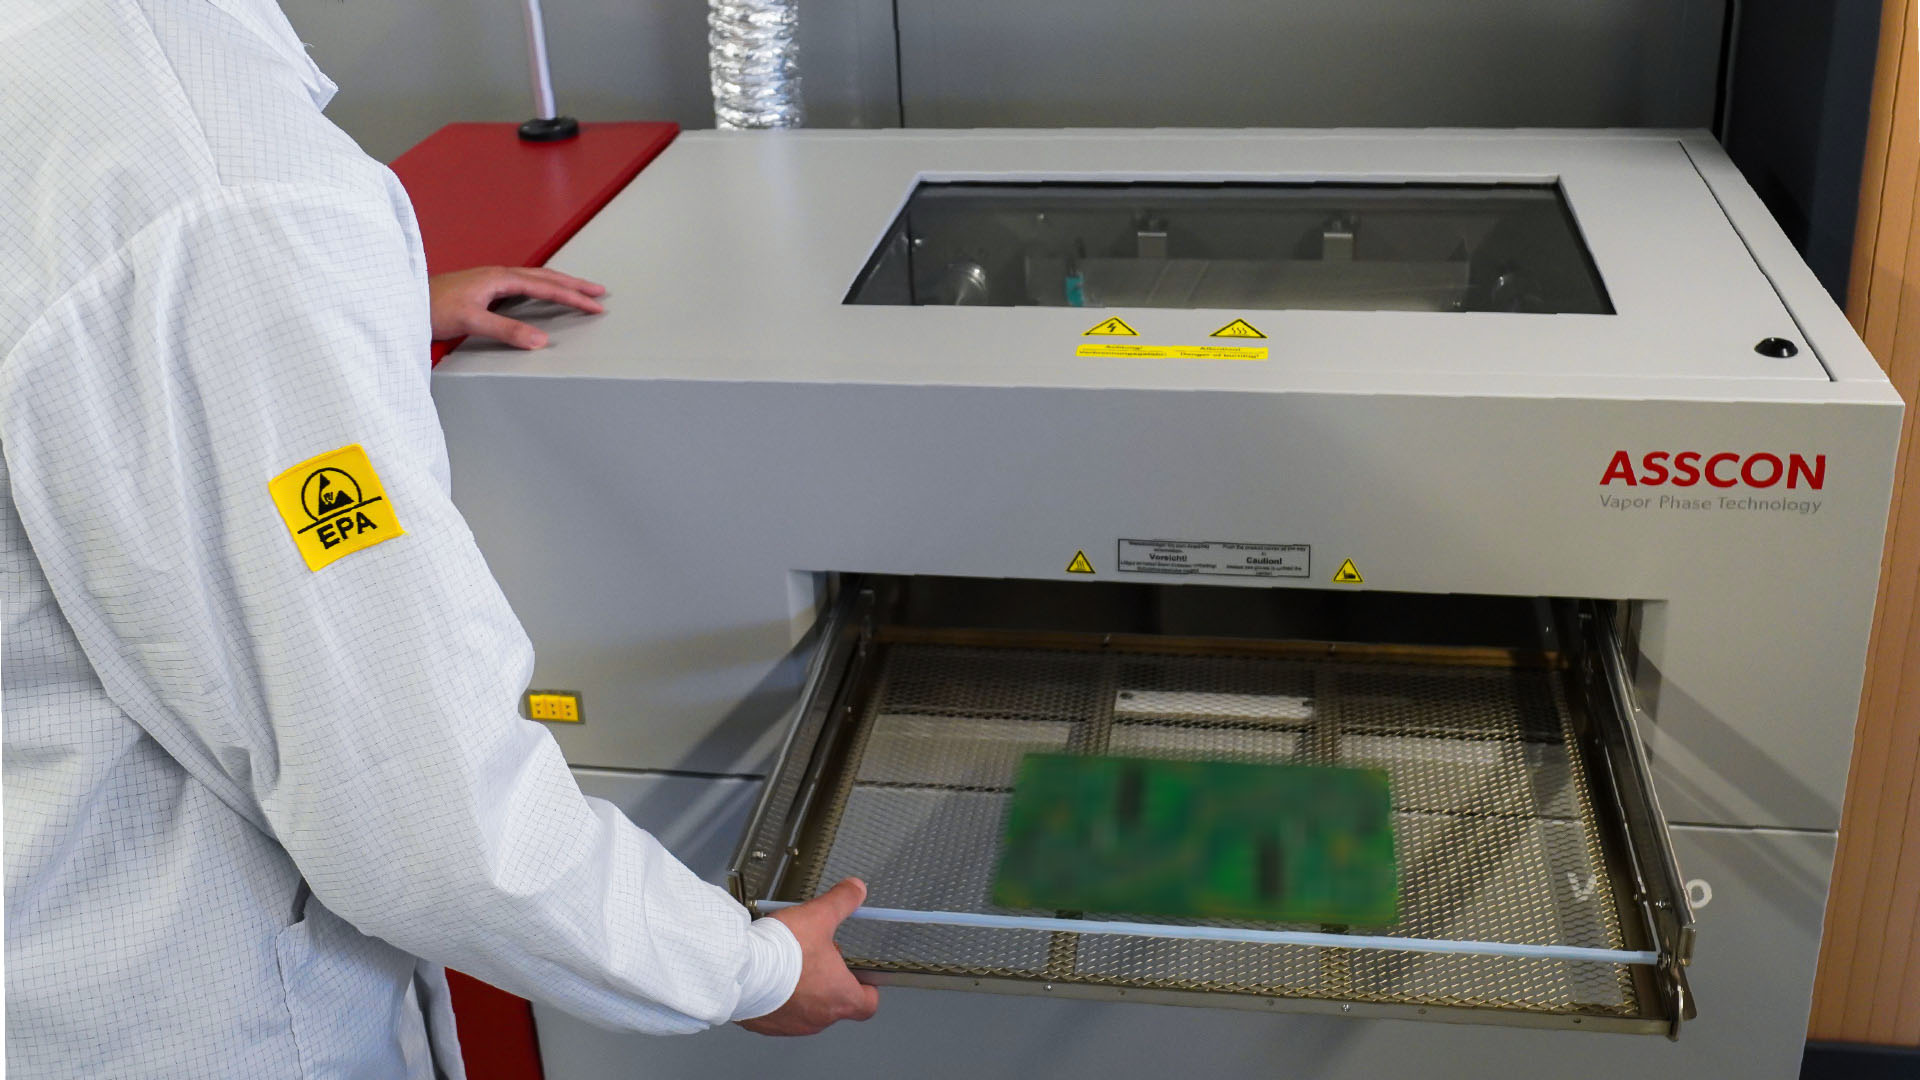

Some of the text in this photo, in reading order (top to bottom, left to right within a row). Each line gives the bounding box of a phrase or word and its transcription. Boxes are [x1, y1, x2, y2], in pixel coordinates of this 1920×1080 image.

[1599, 450, 1826, 490] ASSCON
[1600, 494, 1823, 514] Vapor Phase Technology
[316, 512, 378, 550] EPA
[1246, 556, 1283, 566] Caution!
